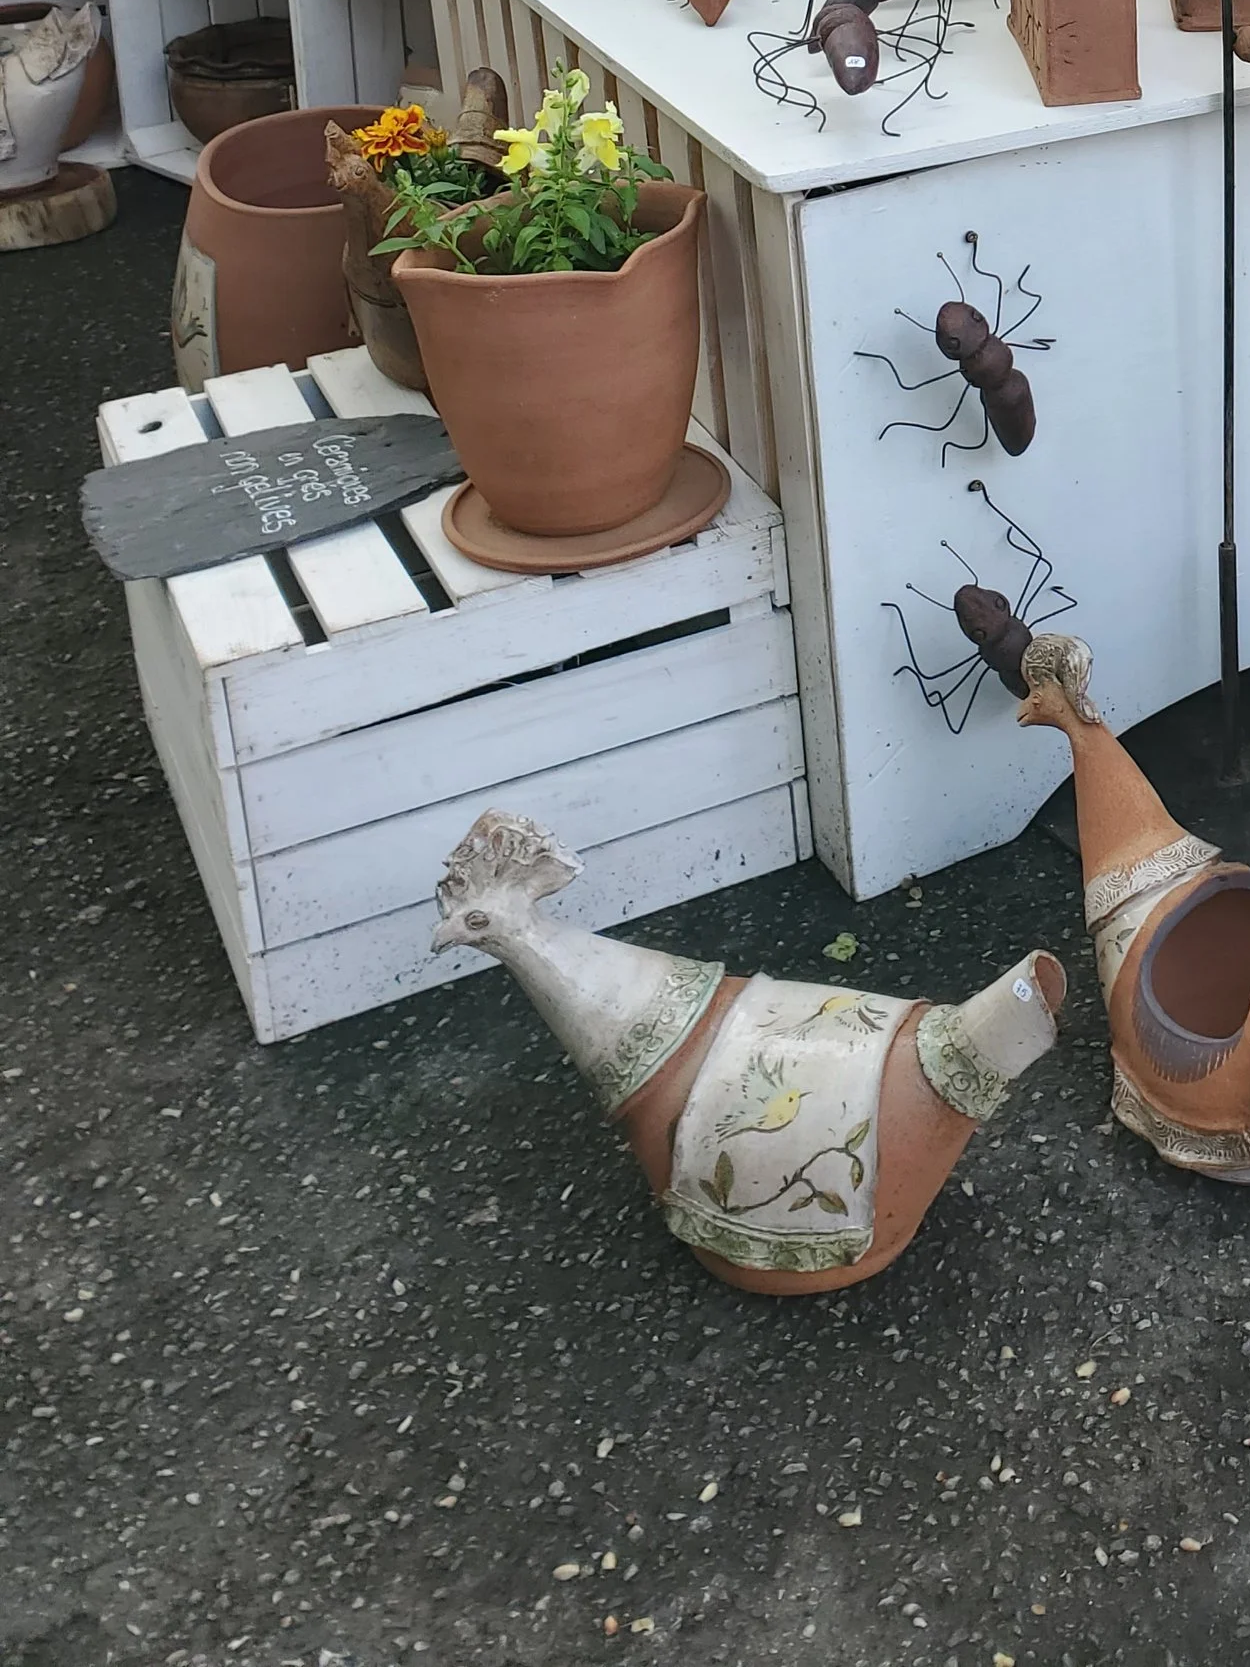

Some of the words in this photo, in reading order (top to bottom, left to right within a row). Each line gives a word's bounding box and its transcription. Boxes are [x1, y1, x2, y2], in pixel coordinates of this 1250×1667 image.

[219, 450, 260, 476] non
[278, 452, 304, 467] en
[313, 434, 372, 506] Céramiques
